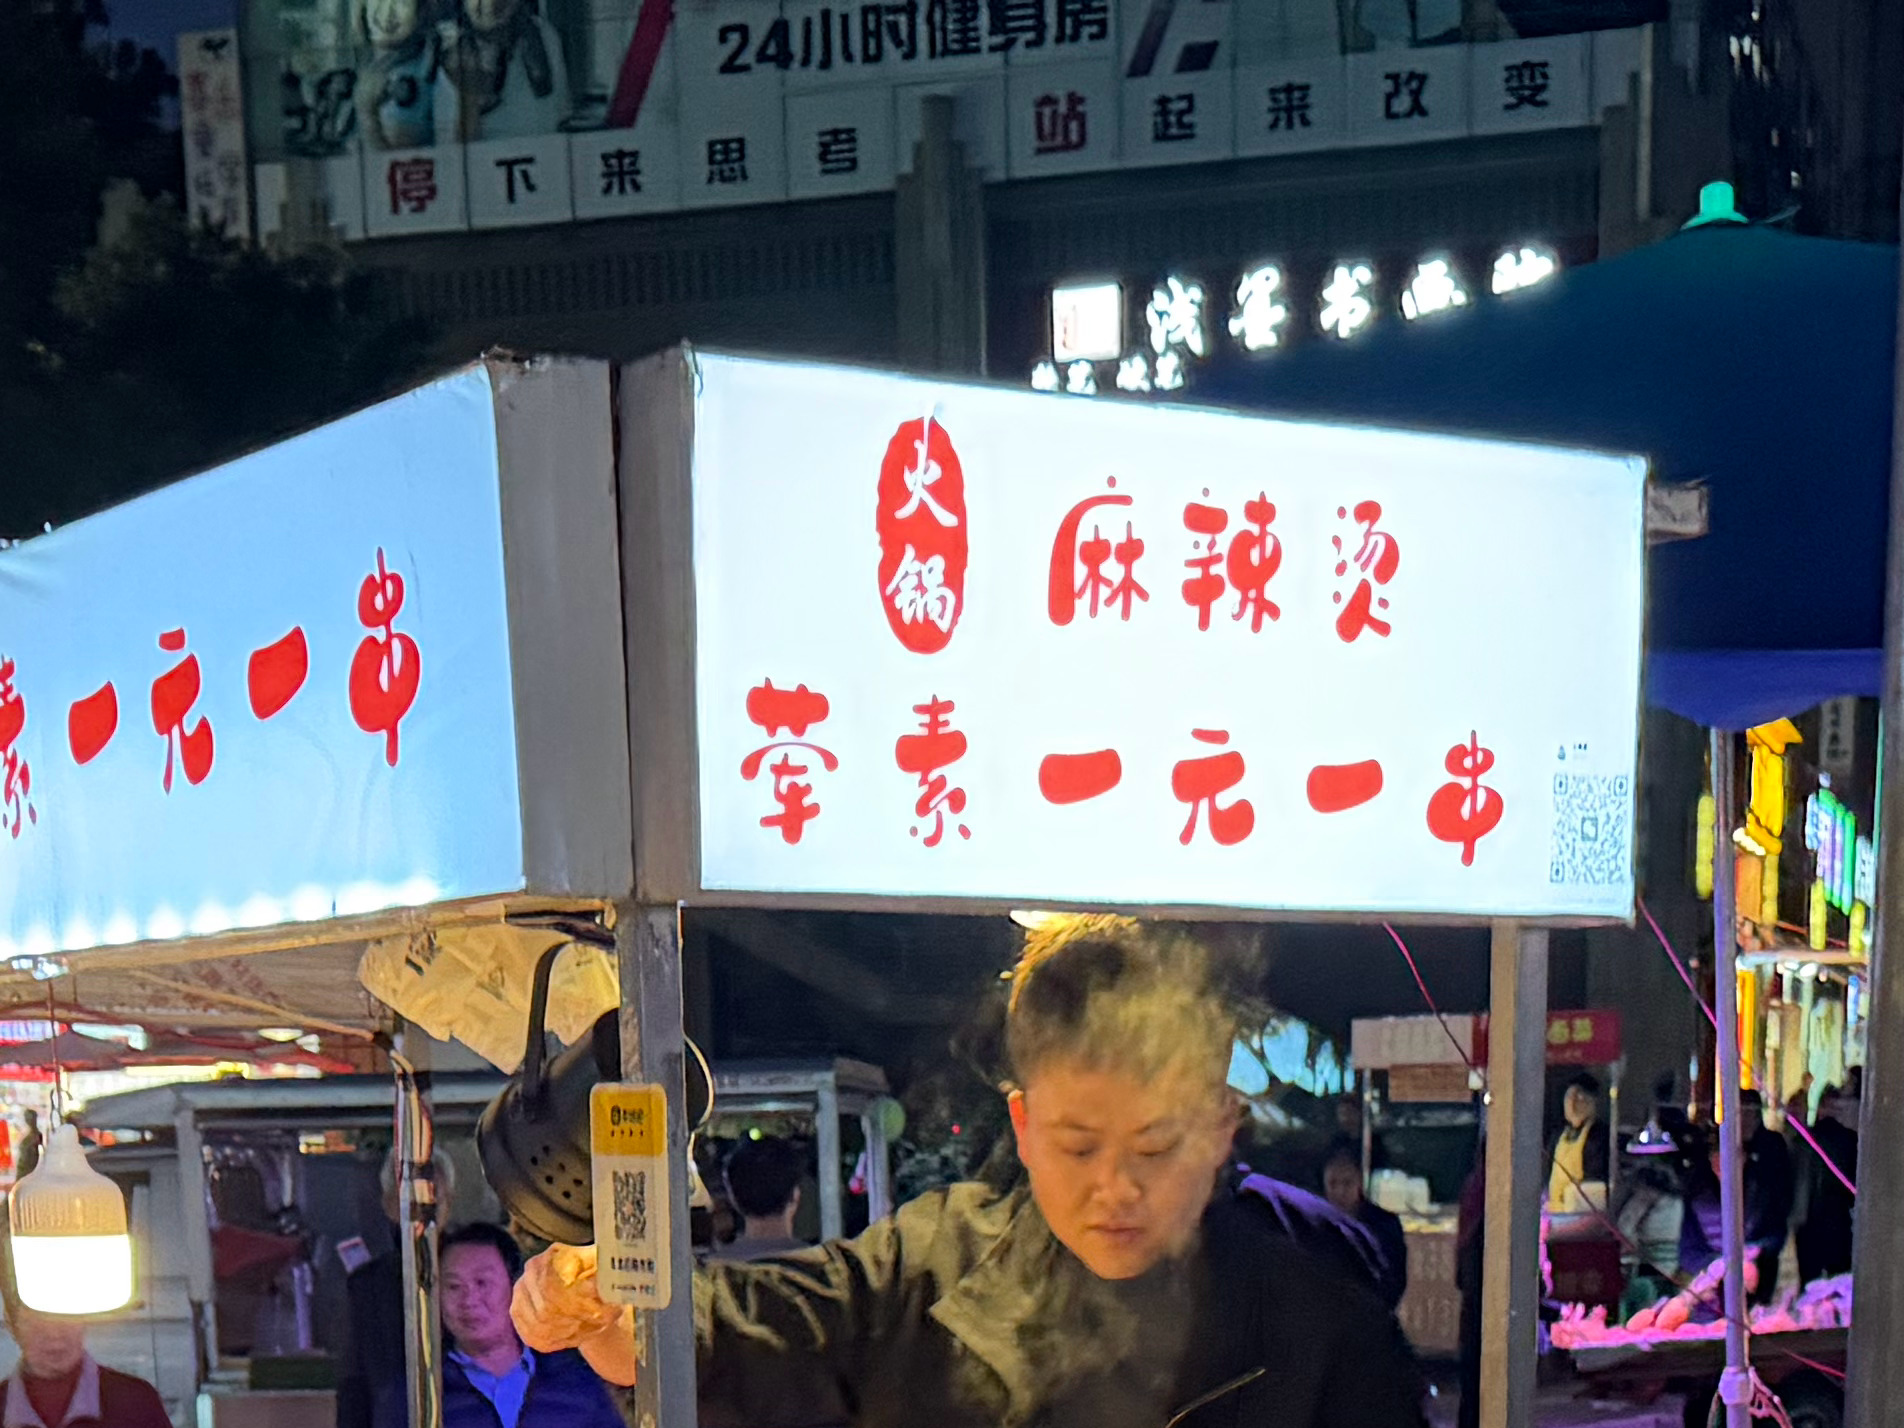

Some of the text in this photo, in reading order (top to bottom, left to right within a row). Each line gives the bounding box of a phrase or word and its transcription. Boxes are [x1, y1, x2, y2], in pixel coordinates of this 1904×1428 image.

[718, 0, 1110, 74] 24小时健身房
[387, 126, 860, 215] 停下来思考
[1033, 61, 1550, 155] 站起来改变
[888, 412, 960, 630] 火锅
[1048, 475, 1400, 643] 麻辣烫
[741, 676, 1504, 867] 荤素一元一串
